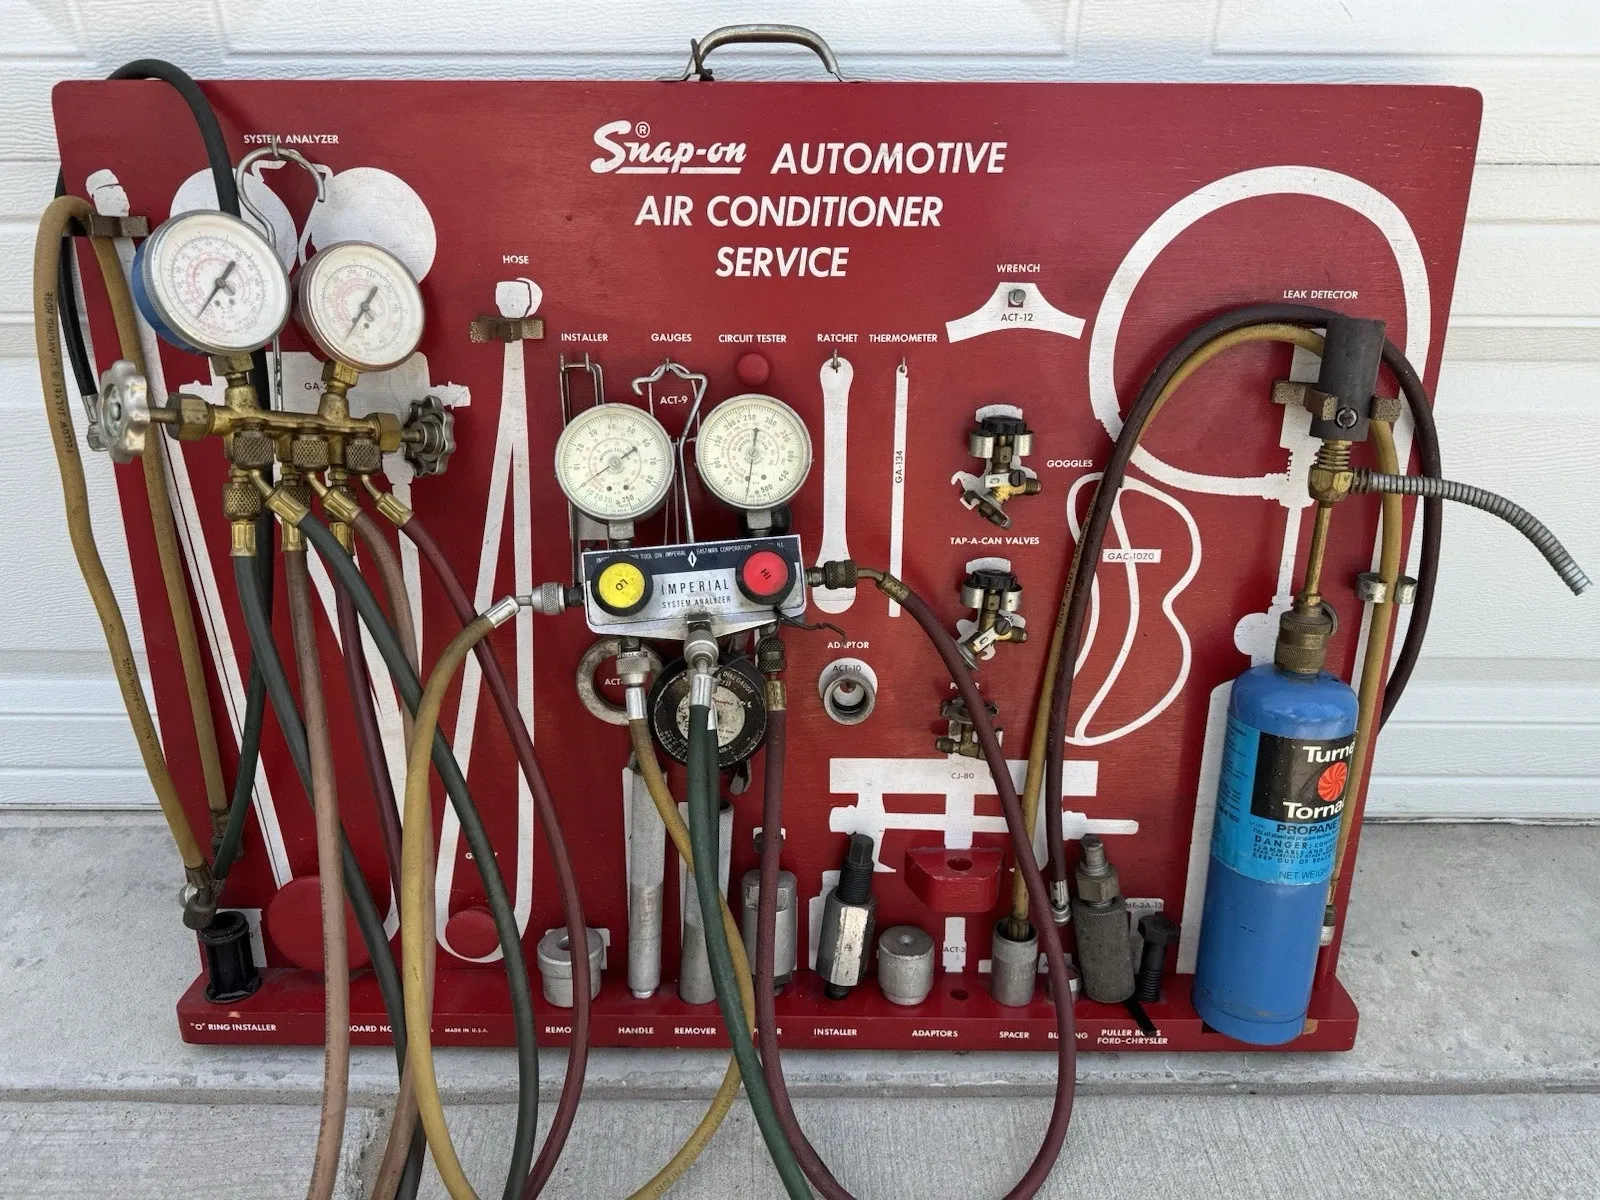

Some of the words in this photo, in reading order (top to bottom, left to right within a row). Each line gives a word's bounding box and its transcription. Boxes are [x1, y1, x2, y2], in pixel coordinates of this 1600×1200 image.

[286, 134, 339, 144] ANALYZER
[590, 120, 747, 174] Snap-on
[770, 141, 1008, 175] AUTOMOTIVE
[634, 195, 694, 226] AIR
[706, 195, 944, 228] CONDITIONER
[502, 255, 530, 264] HOSE
[715, 246, 850, 278] SERVICE
[996, 264, 1040, 273] WRENCH
[1284, 290, 1307, 299] LEAK
[1310, 290, 1358, 299] DETECTOR
[1000, 313, 1034, 321] ACT-12
[561, 333, 608, 342] INSTALLER
[651, 333, 692, 342] GAUGES
[718, 334, 754, 343] CIRCUIT
[756, 334, 787, 343] TESTER
[817, 334, 858, 343] RATCHET
[869, 334, 938, 343] THERMOMETER
[660, 396, 688, 404] ACT-9
[894, 450, 903, 483] GA-134
[1047, 460, 1093, 468] GOGGLES
[760, 569, 772, 580] HI
[661, 579, 729, 595] IMPERIAL
[662, 599, 690, 608] SYSTEM
[694, 596, 731, 606] ANALYZER
[1302, 740, 1356, 763] Turne
[1283, 799, 1344, 819] Torna
[1277, 820, 1337, 834] PROPANE
[1255, 835, 1312, 849] DANGER:
[546, 1026, 573, 1034] REMO
[674, 1027, 717, 1035] REMOVER
[814, 1028, 858, 1036] INSTALLER
